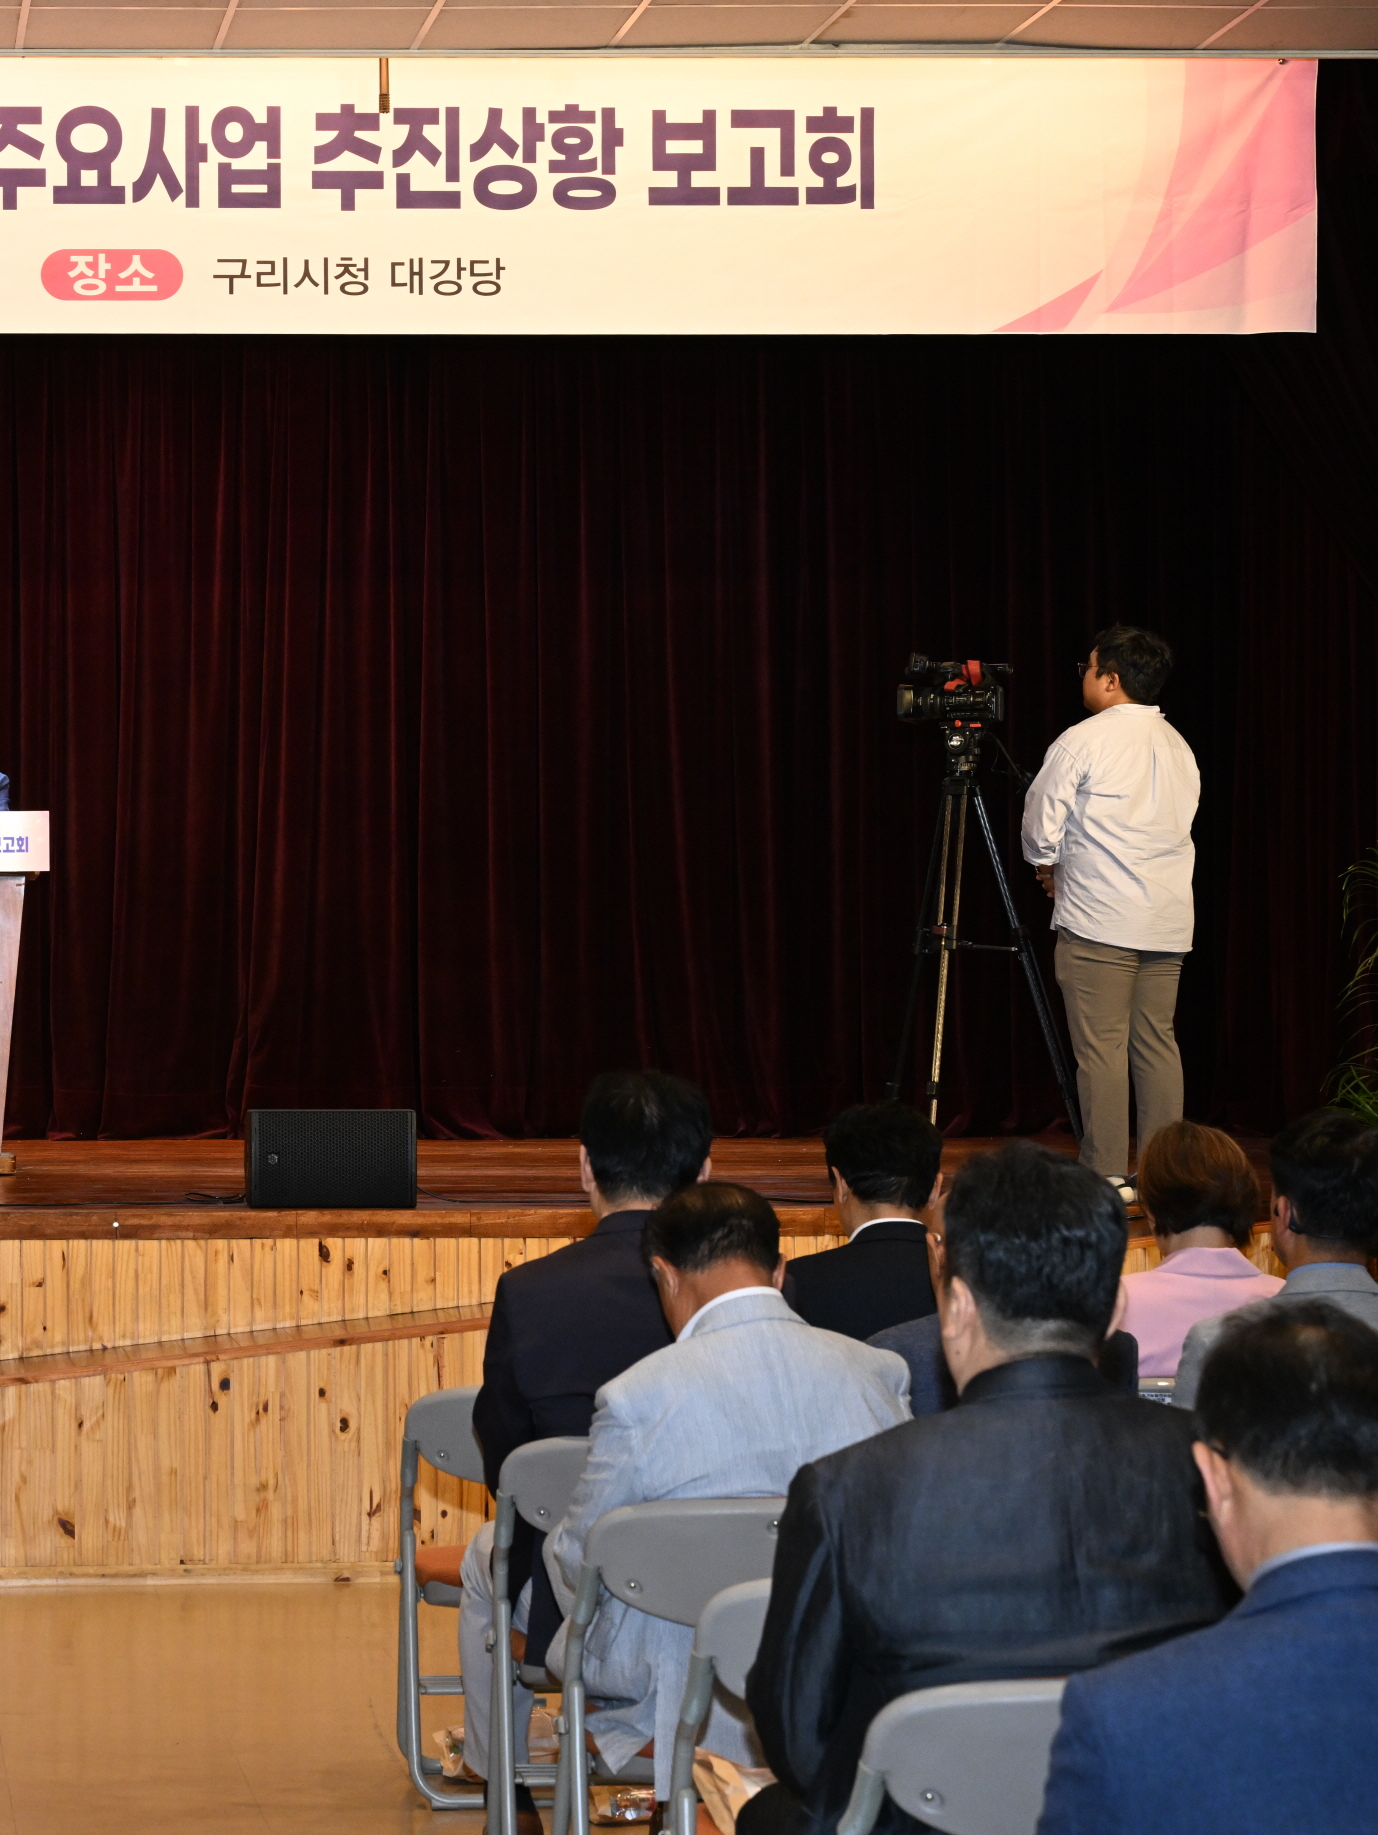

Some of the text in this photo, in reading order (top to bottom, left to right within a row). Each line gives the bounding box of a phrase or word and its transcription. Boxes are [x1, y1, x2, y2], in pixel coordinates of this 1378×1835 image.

[312, 104, 624, 212] 추진상황
[648, 107, 875, 210] 보고회
[67, 254, 158, 296] 장소
[213, 257, 506, 297] 구리시청 대강당
